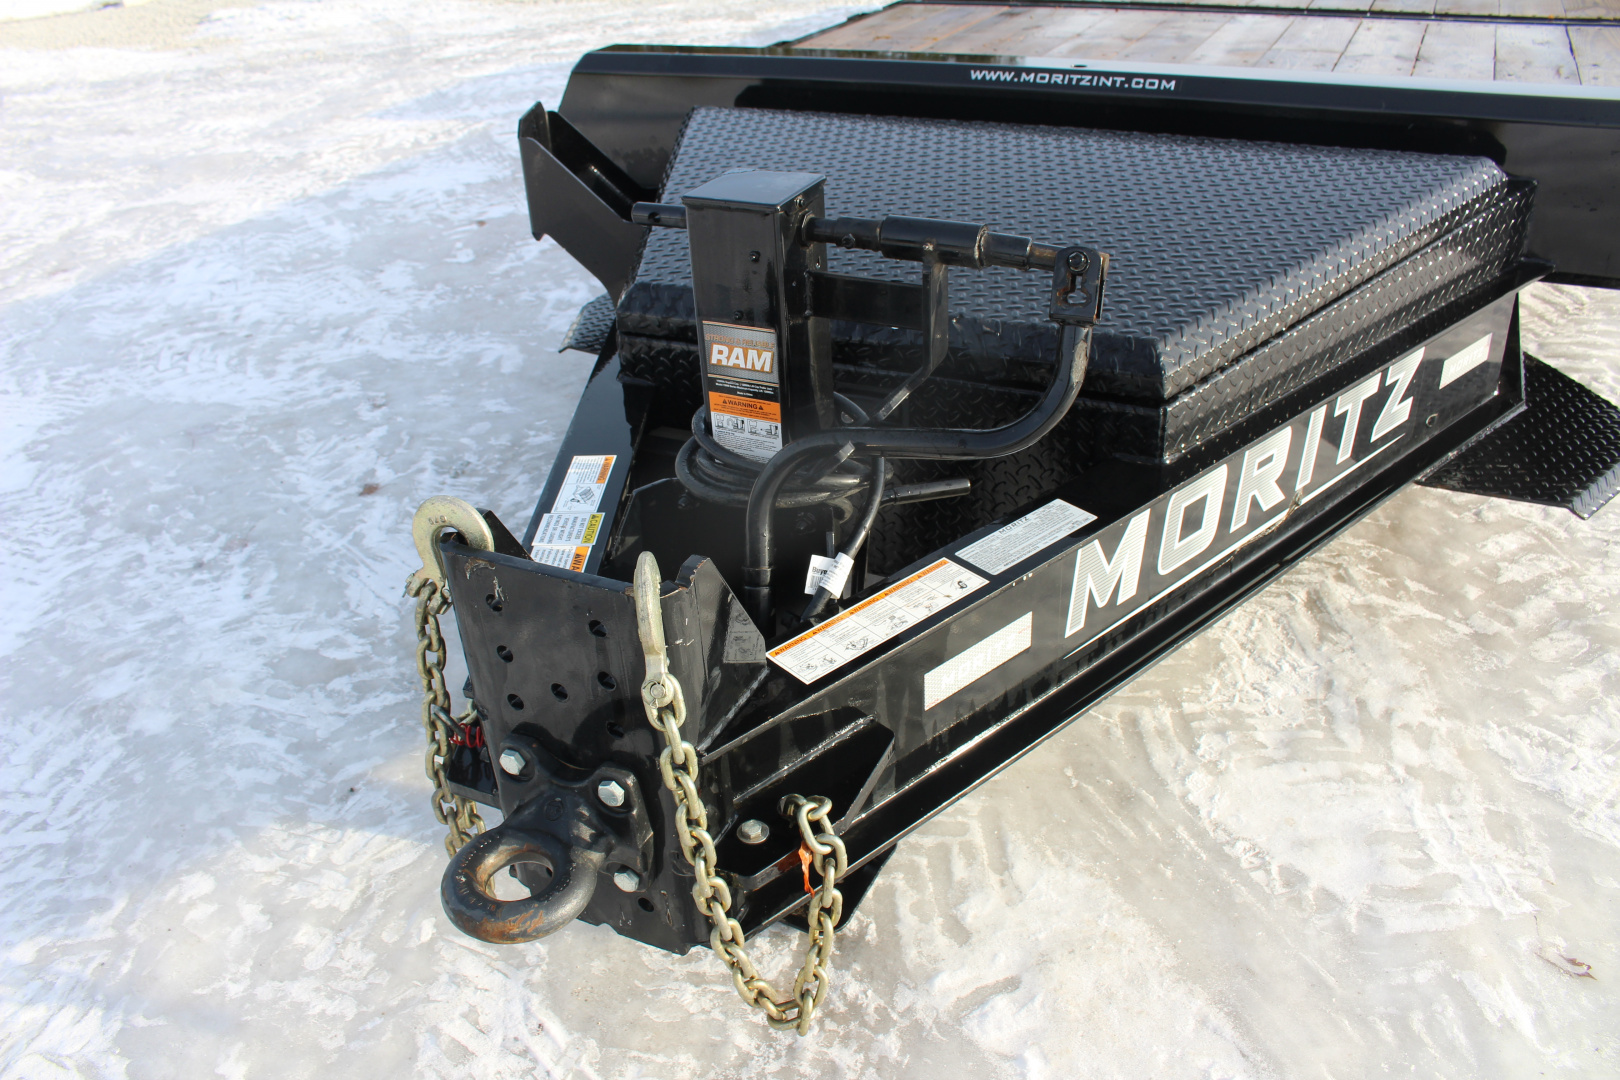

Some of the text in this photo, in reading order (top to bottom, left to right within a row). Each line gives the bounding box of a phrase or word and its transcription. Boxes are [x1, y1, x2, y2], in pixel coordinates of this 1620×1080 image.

[970, 70, 1176, 91] WWW.MORITZINT.COM
[705, 333, 734, 344] STRONG
[742, 338, 775, 349] RELIABLE
[711, 344, 771, 371] RAM
[728, 400, 758, 410] WARNING
[1063, 346, 1426, 638] MORITZ
[584, 520, 597, 542] CAUTION
[998, 516, 1029, 534] MORITZ
[850, 597, 879, 613] WARNING
[815, 616, 843, 632] WARNING
[778, 636, 807, 652] WARNING
